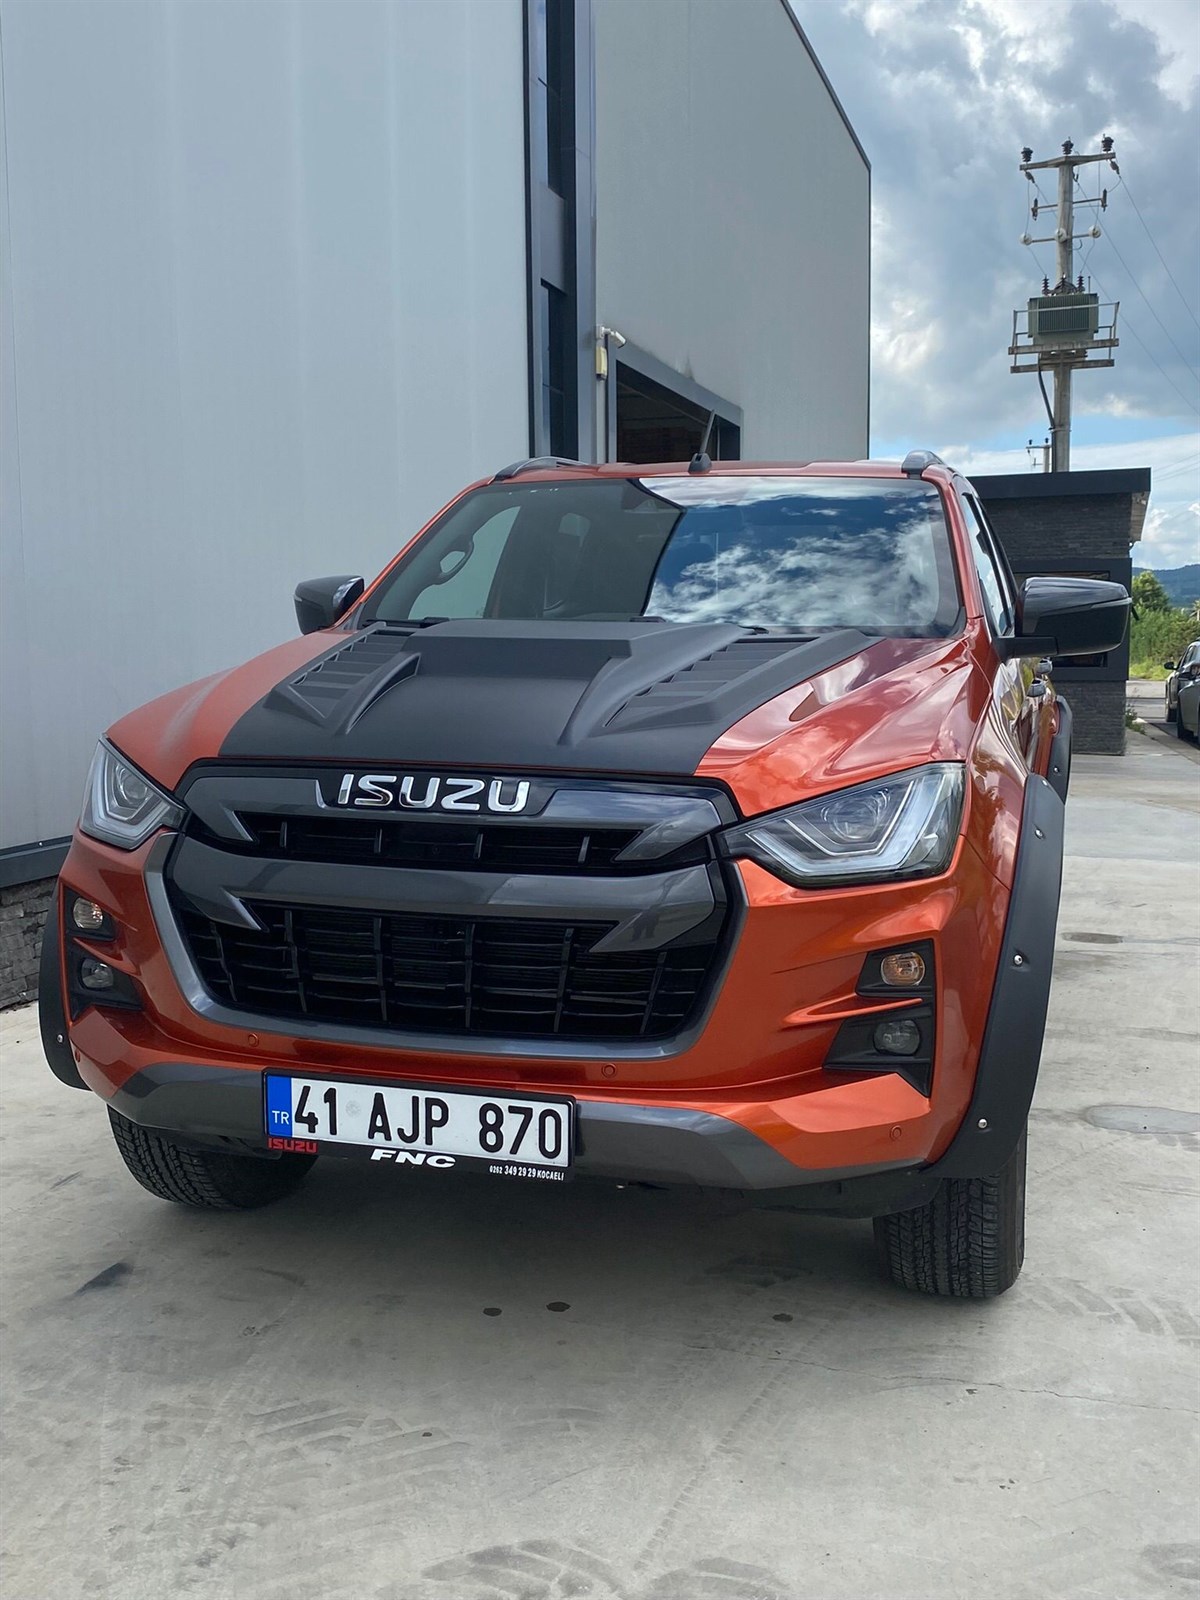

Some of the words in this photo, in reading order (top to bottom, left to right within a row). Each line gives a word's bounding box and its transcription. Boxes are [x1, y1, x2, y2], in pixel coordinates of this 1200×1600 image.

[337, 774, 530, 812] ISUZU
[271, 1110, 290, 1125] TR
[294, 1085, 338, 1135] 41
[367, 1092, 449, 1145] AJP
[478, 1102, 562, 1160] 870
[268, 1138, 318, 1153] ISUZU
[370, 1148, 456, 1168] FNC
[489, 1165, 503, 1174] 0262
[504, 1165, 518, 1176] 349
[518, 1166, 527, 1177] 29
[527, 1167, 537, 1178] 29
[536, 1169, 565, 1181] KOCAELI
